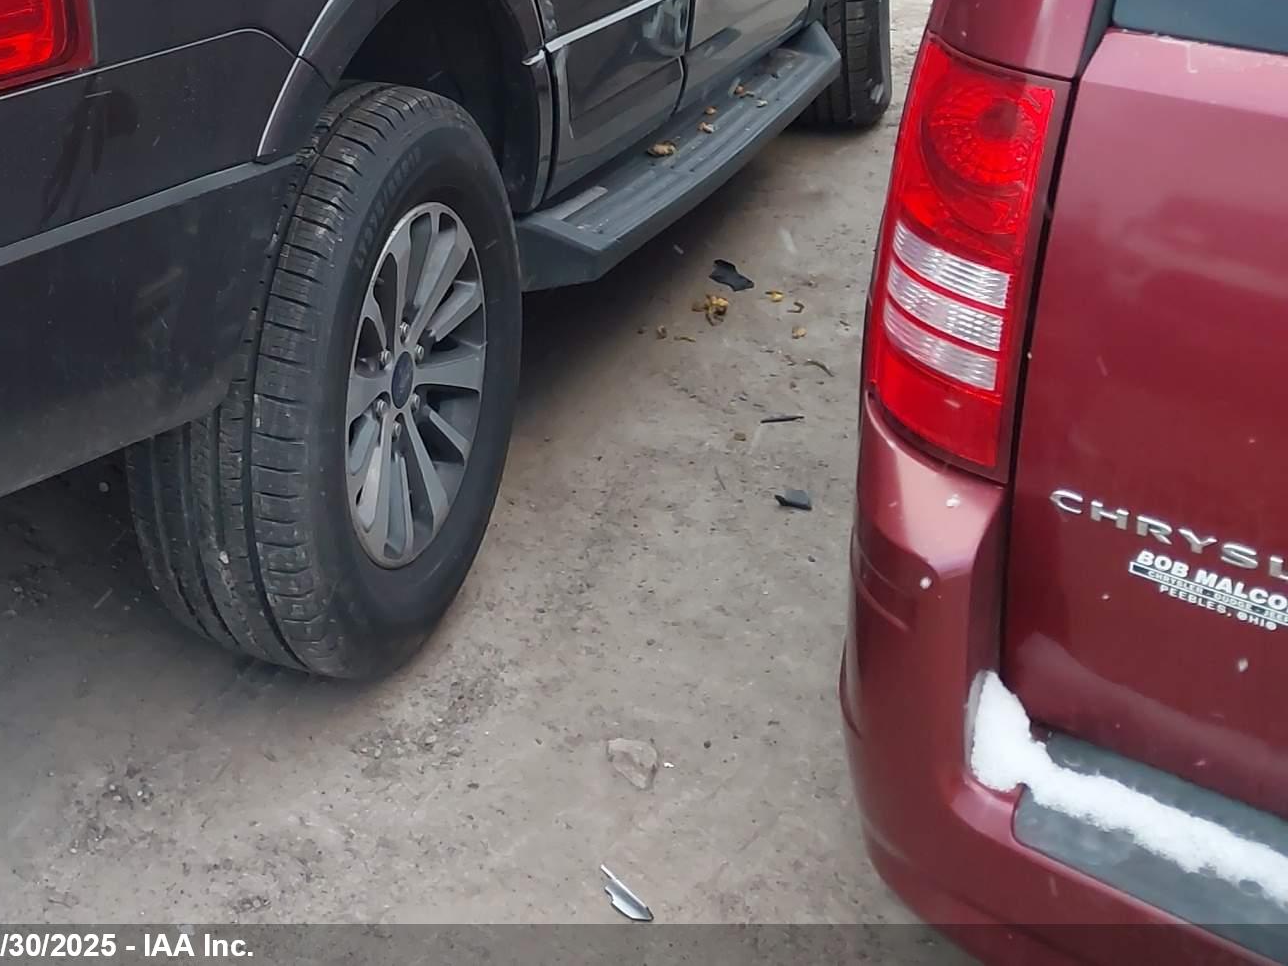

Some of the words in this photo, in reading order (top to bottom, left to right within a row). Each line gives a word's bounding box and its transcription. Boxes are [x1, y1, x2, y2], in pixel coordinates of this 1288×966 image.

[1136, 550, 1189, 578] BOB
[1194, 569, 1288, 614] MALCO
[1236, 611, 1277, 631] OHIO
